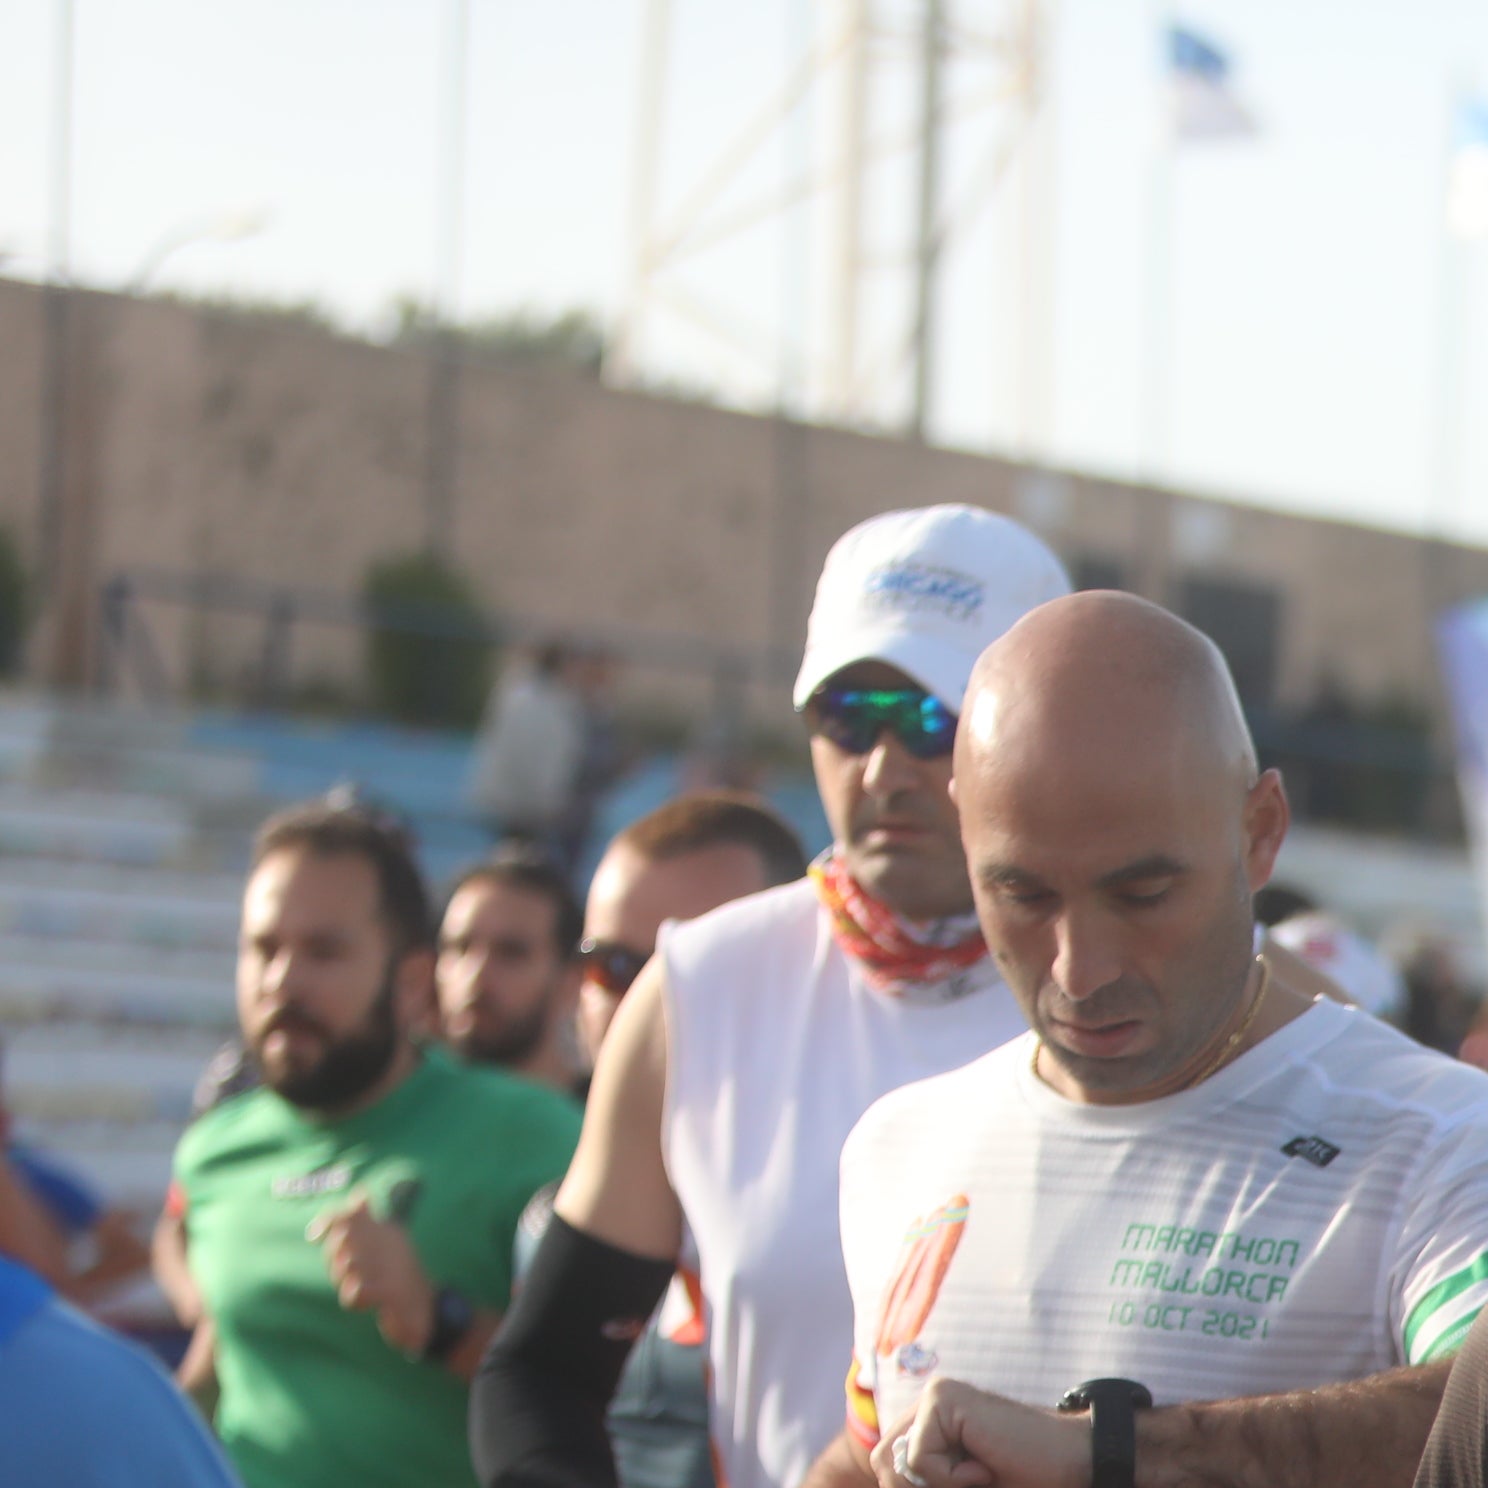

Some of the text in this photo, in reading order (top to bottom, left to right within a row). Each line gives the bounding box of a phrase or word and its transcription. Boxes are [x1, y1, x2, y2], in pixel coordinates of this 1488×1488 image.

[1121, 1223, 1300, 1267] MARATHON
[1109, 1259, 1289, 1303] MALLORCA
[1108, 1303, 1269, 1340] 10 OCT 2021
